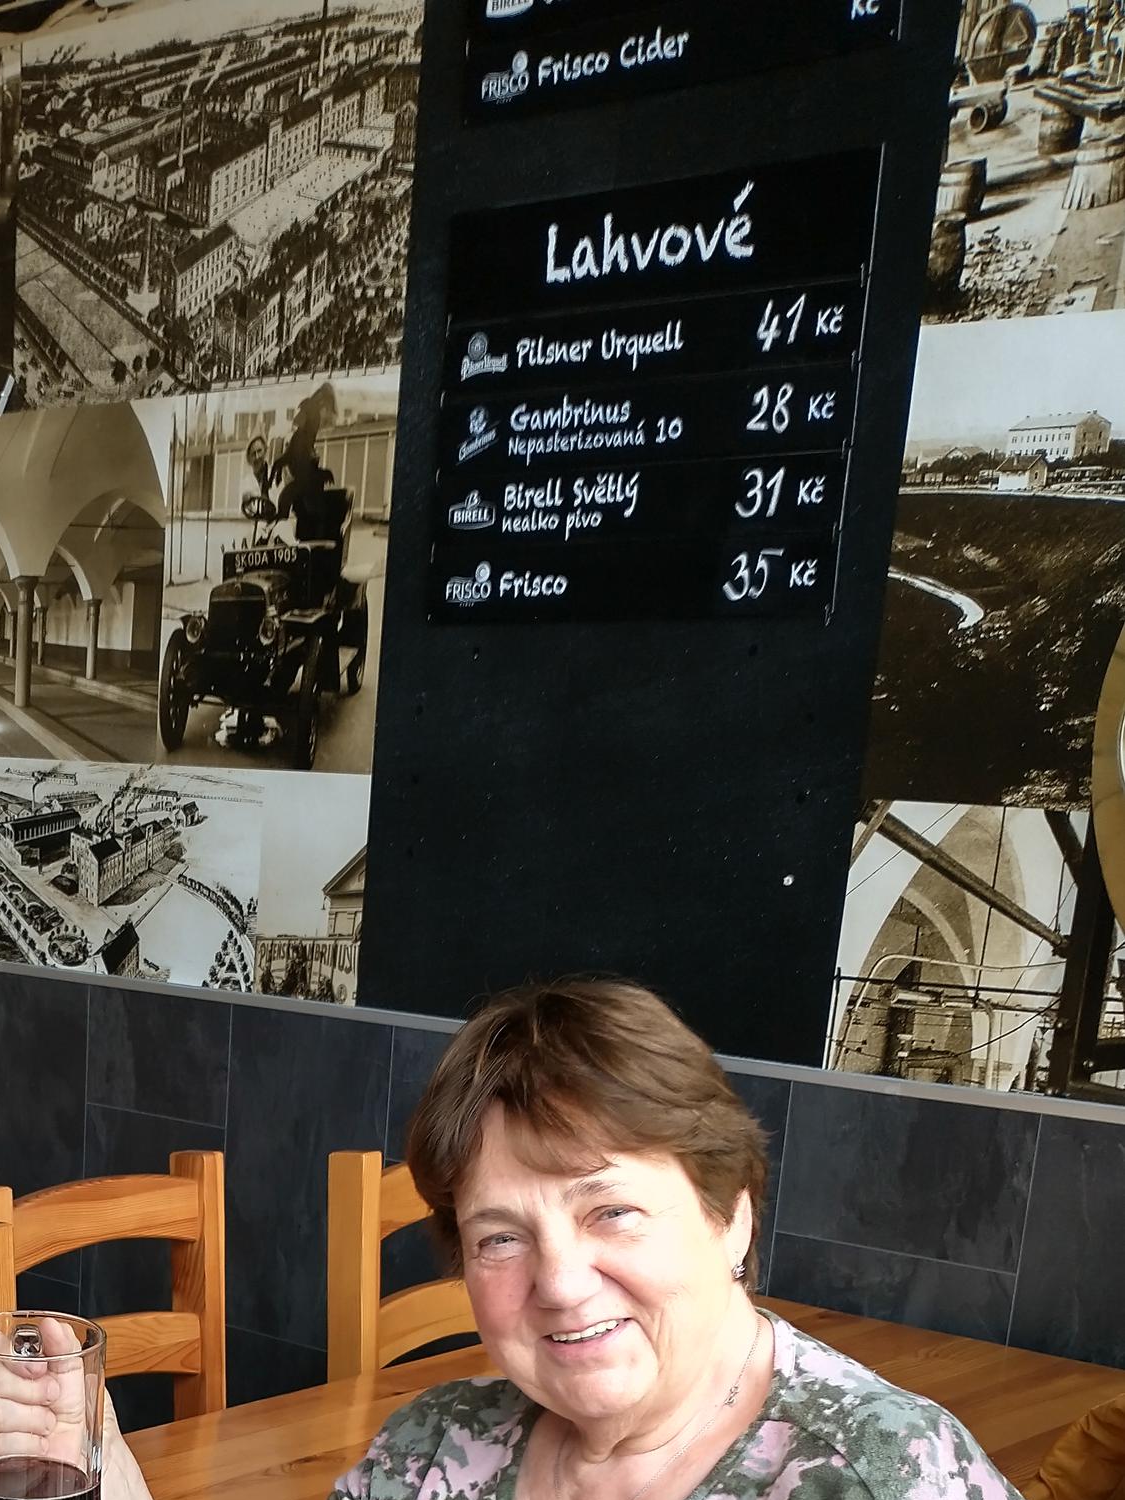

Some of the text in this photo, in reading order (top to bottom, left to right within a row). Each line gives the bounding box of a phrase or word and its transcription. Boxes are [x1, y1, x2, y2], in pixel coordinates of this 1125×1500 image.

[538, 26, 689, 87] Frisco Cider
[546, 180, 754, 284] Lahvové
[516, 293, 844, 372] Pilsner Urquell 41 Kč
[510, 383, 836, 434] Gambrinus 28 Kč
[508, 416, 683, 467] Nepasterizovaná 10
[454, 508, 491, 524] BIRELL
[503, 466, 826, 518] Birell Světlý 31 Kč
[501, 507, 603, 541] nealko pivo
[274, 547, 297, 564] 1905
[499, 548, 818, 601] Frisco 35 Kč
[445, 580, 492, 601] FRISCO
